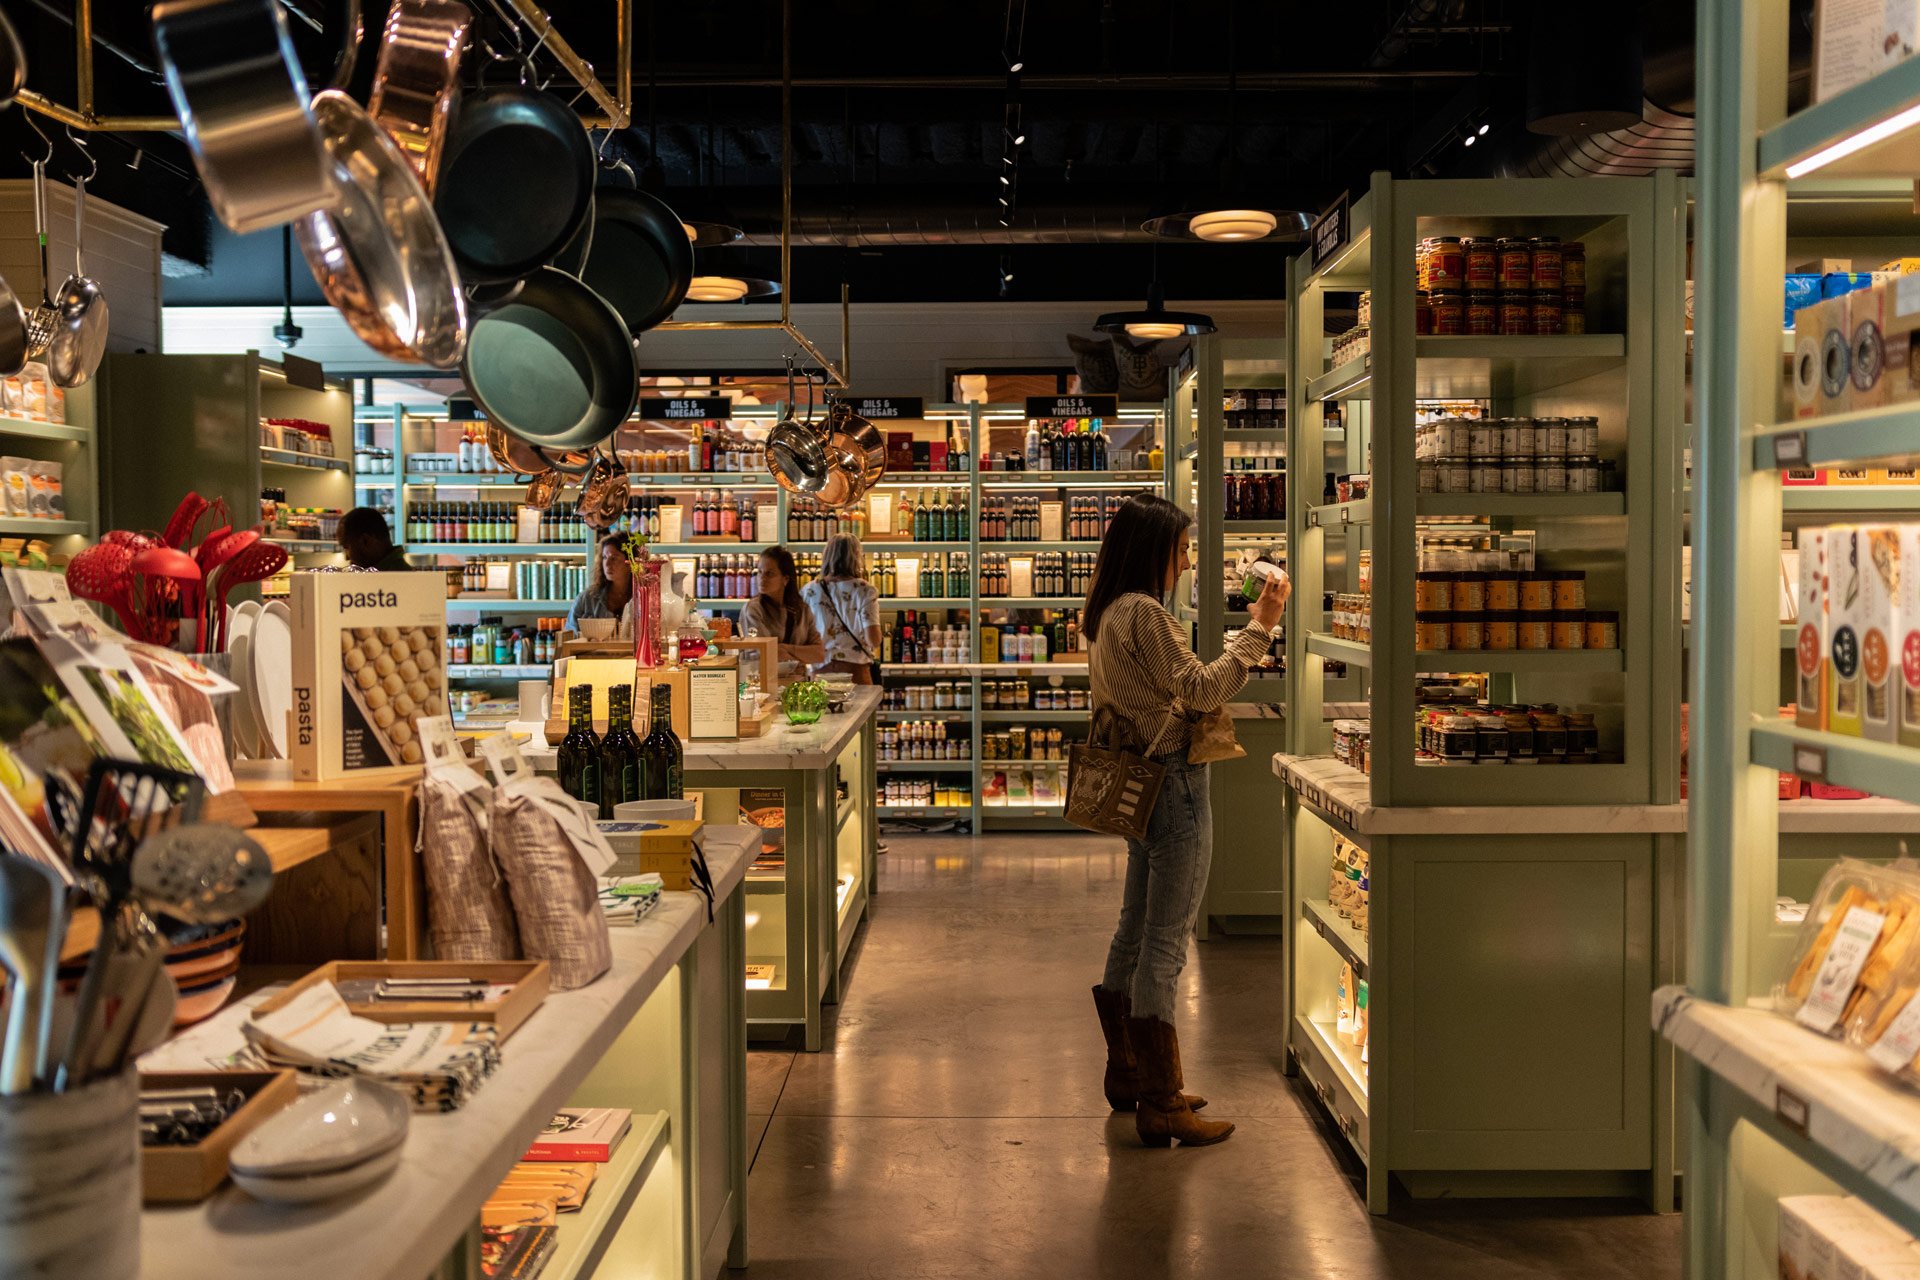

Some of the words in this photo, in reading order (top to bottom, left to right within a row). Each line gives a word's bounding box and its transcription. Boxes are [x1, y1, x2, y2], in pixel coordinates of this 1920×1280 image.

[670, 401, 689, 409] OILS
[691, 401, 697, 409] &
[863, 400, 881, 408] OILS
[884, 400, 890, 408] &
[1057, 399, 1075, 407] OILS
[1078, 399, 1084, 407] &
[665, 409, 705, 417] VINEGARS
[858, 408, 898, 416] VINEGARS
[1052, 407, 1092, 415] VINEGARS
[340, 589, 397, 613] pasta
[1871, 635, 1879, 678] LARK
[1912, 637, 1920, 682] LARK
[294, 687, 314, 745] pasta
